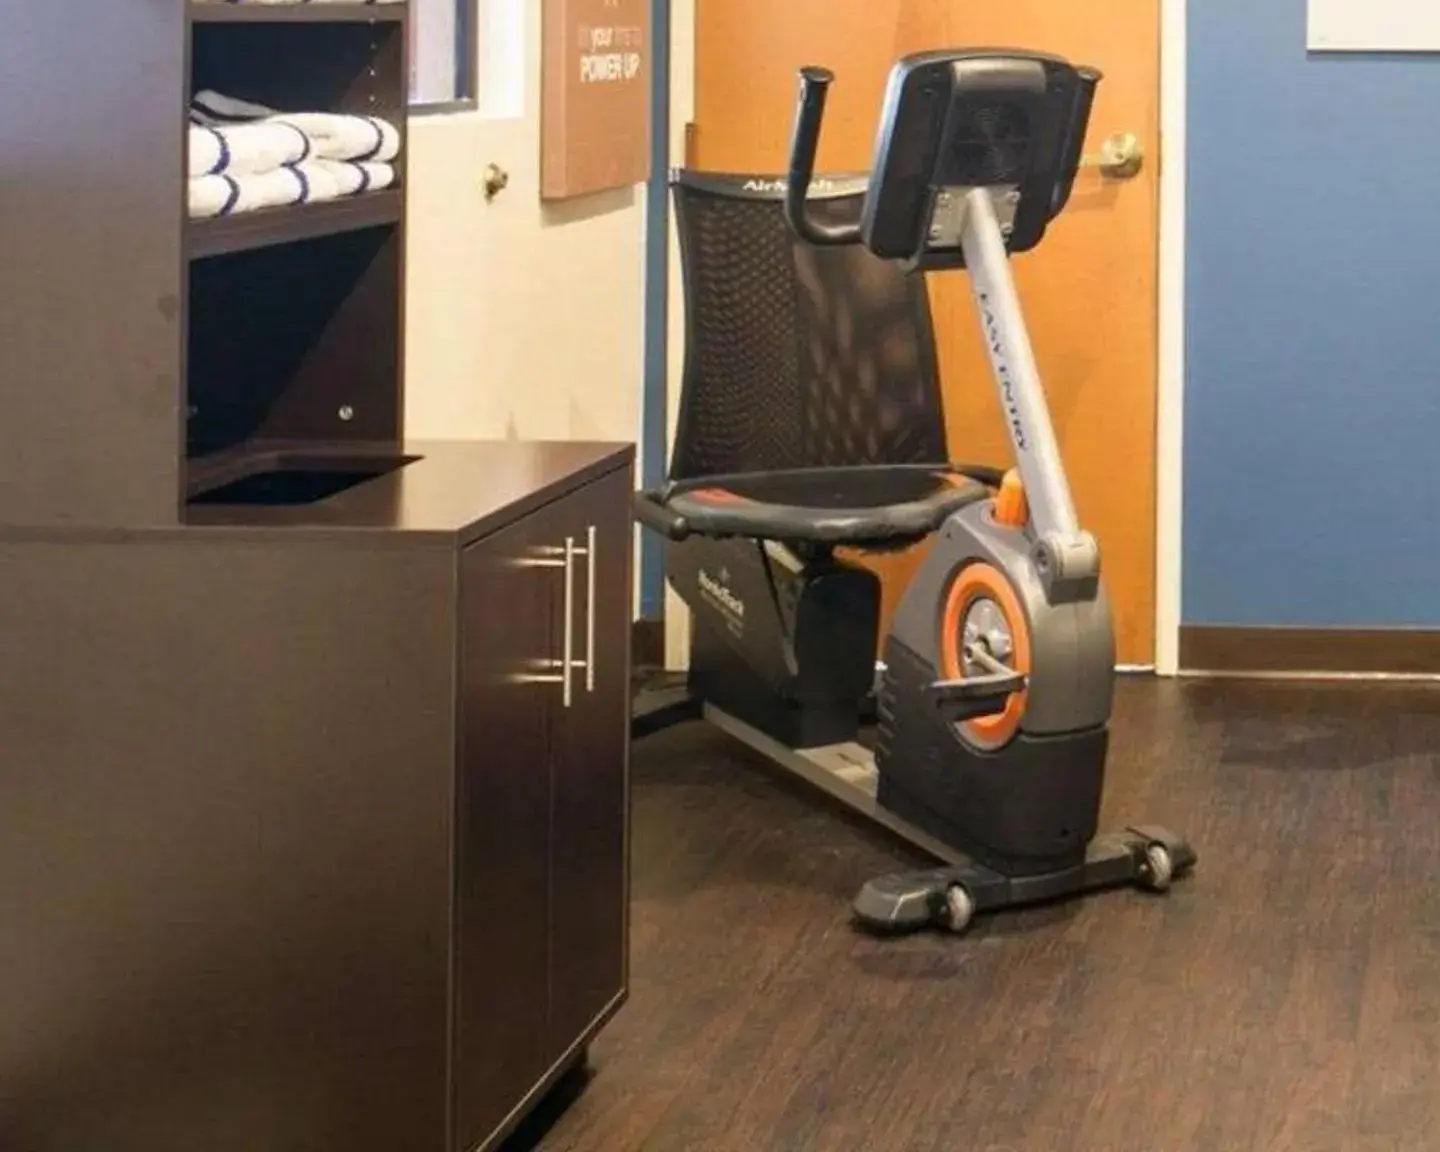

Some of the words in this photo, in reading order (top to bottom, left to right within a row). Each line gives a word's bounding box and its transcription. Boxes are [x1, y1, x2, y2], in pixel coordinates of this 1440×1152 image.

[590, 26, 614, 53] your
[579, 53, 622, 83] POWER
[623, 51, 641, 81] UP
